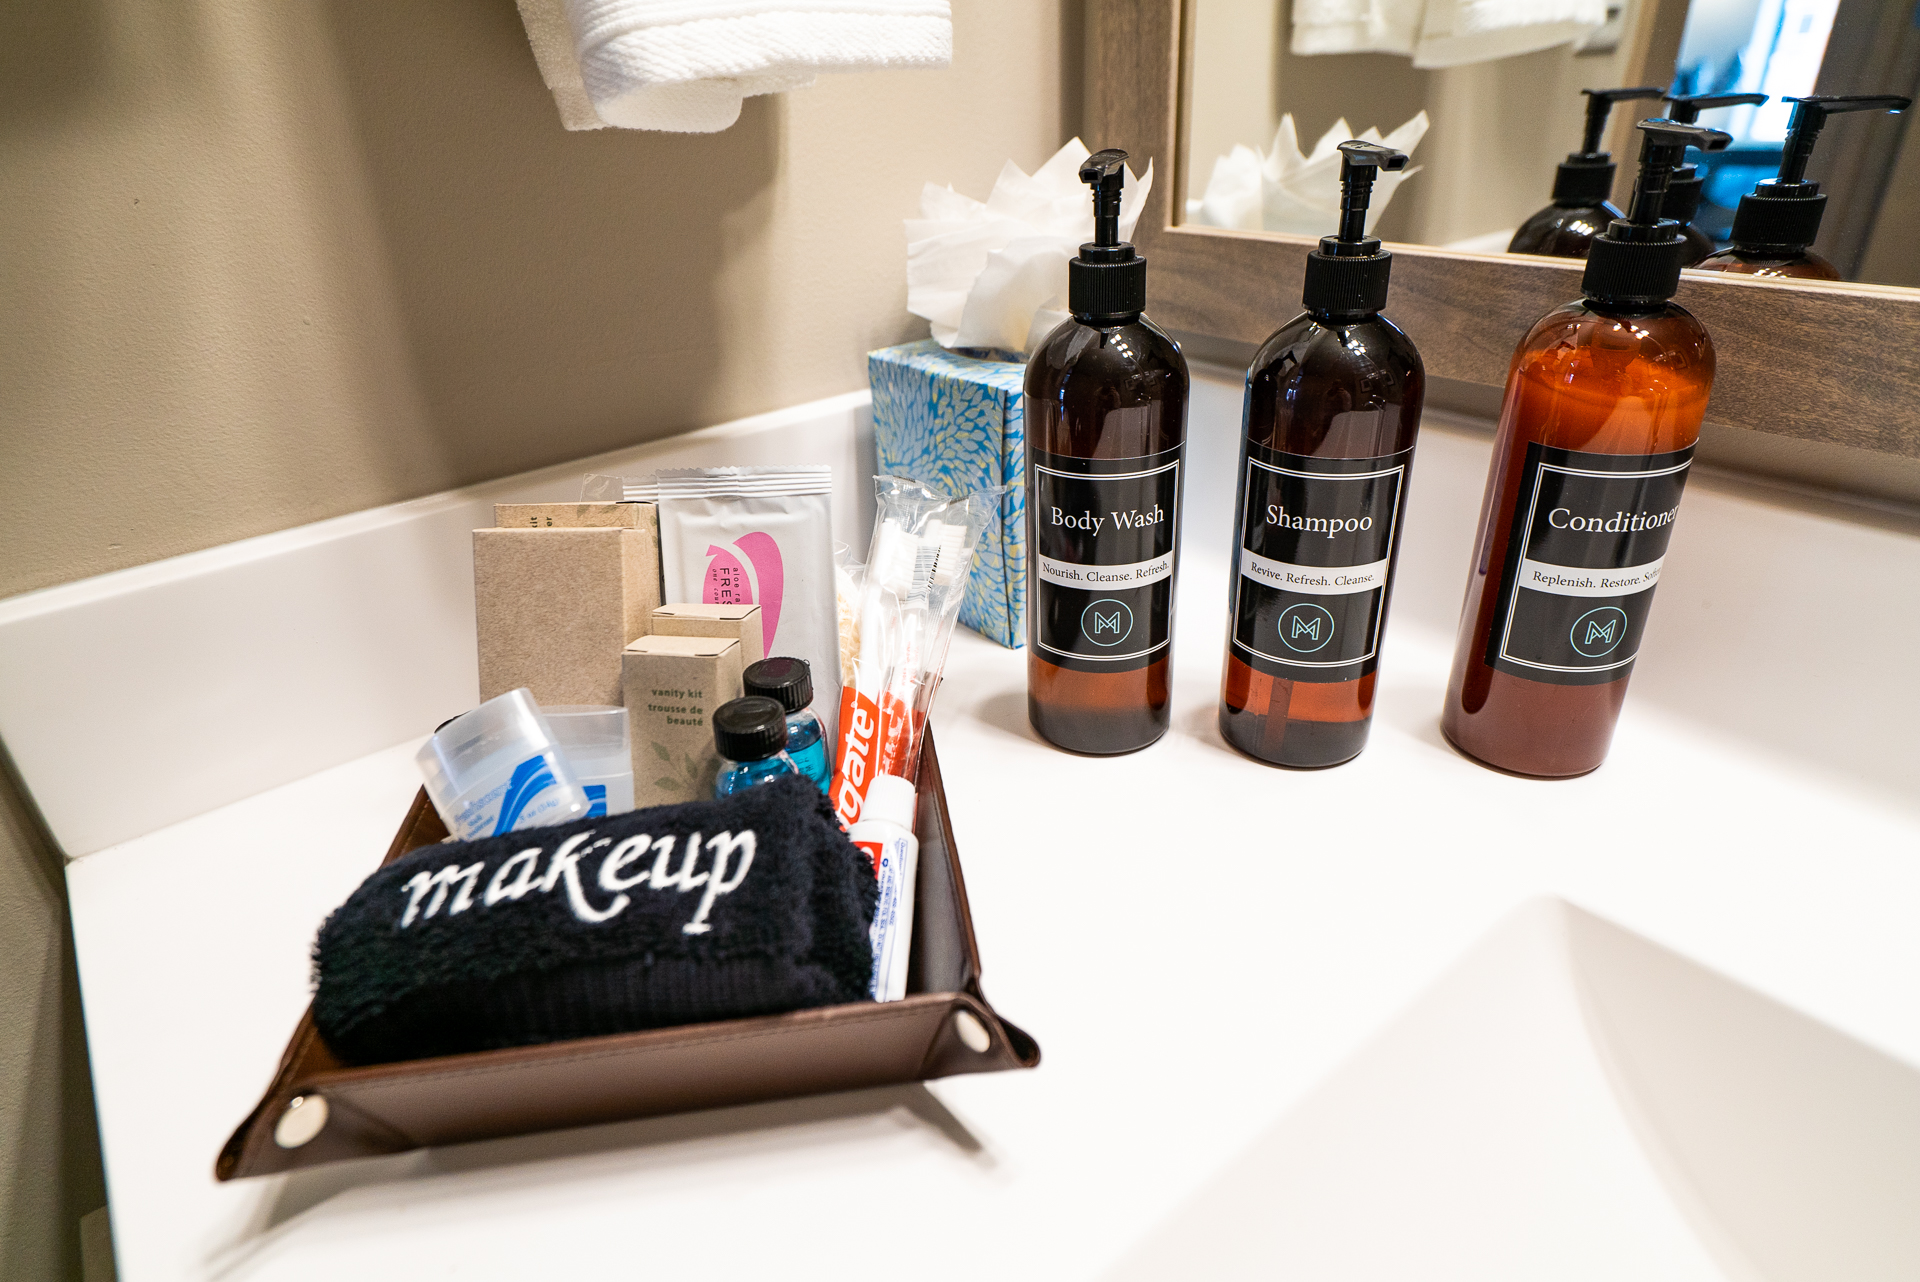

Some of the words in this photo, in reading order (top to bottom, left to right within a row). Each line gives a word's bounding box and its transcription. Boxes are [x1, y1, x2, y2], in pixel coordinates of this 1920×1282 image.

[1050, 505, 1105, 537] Body
[1111, 503, 1165, 531] Wash
[1266, 504, 1373, 539] Shampoo
[1548, 505, 1679, 533] Conditioner
[1042, 561, 1084, 581] Nourish.
[1086, 571, 1133, 583] Cleanse.
[1135, 560, 1170, 580] Refresh.
[1250, 561, 1283, 581] Revive.
[1285, 572, 1331, 586] Refresh.
[1334, 573, 1375, 586] Cleanse.
[1532, 570, 1596, 588] Replenish.
[1600, 575, 1641, 589] Restore.
[651, 688, 686, 700] vanity
[687, 688, 703, 699] kit
[647, 702, 687, 714] trousse
[690, 705, 703, 715] de
[666, 715, 703, 726] beauté
[400, 828, 757, 935] makeup
